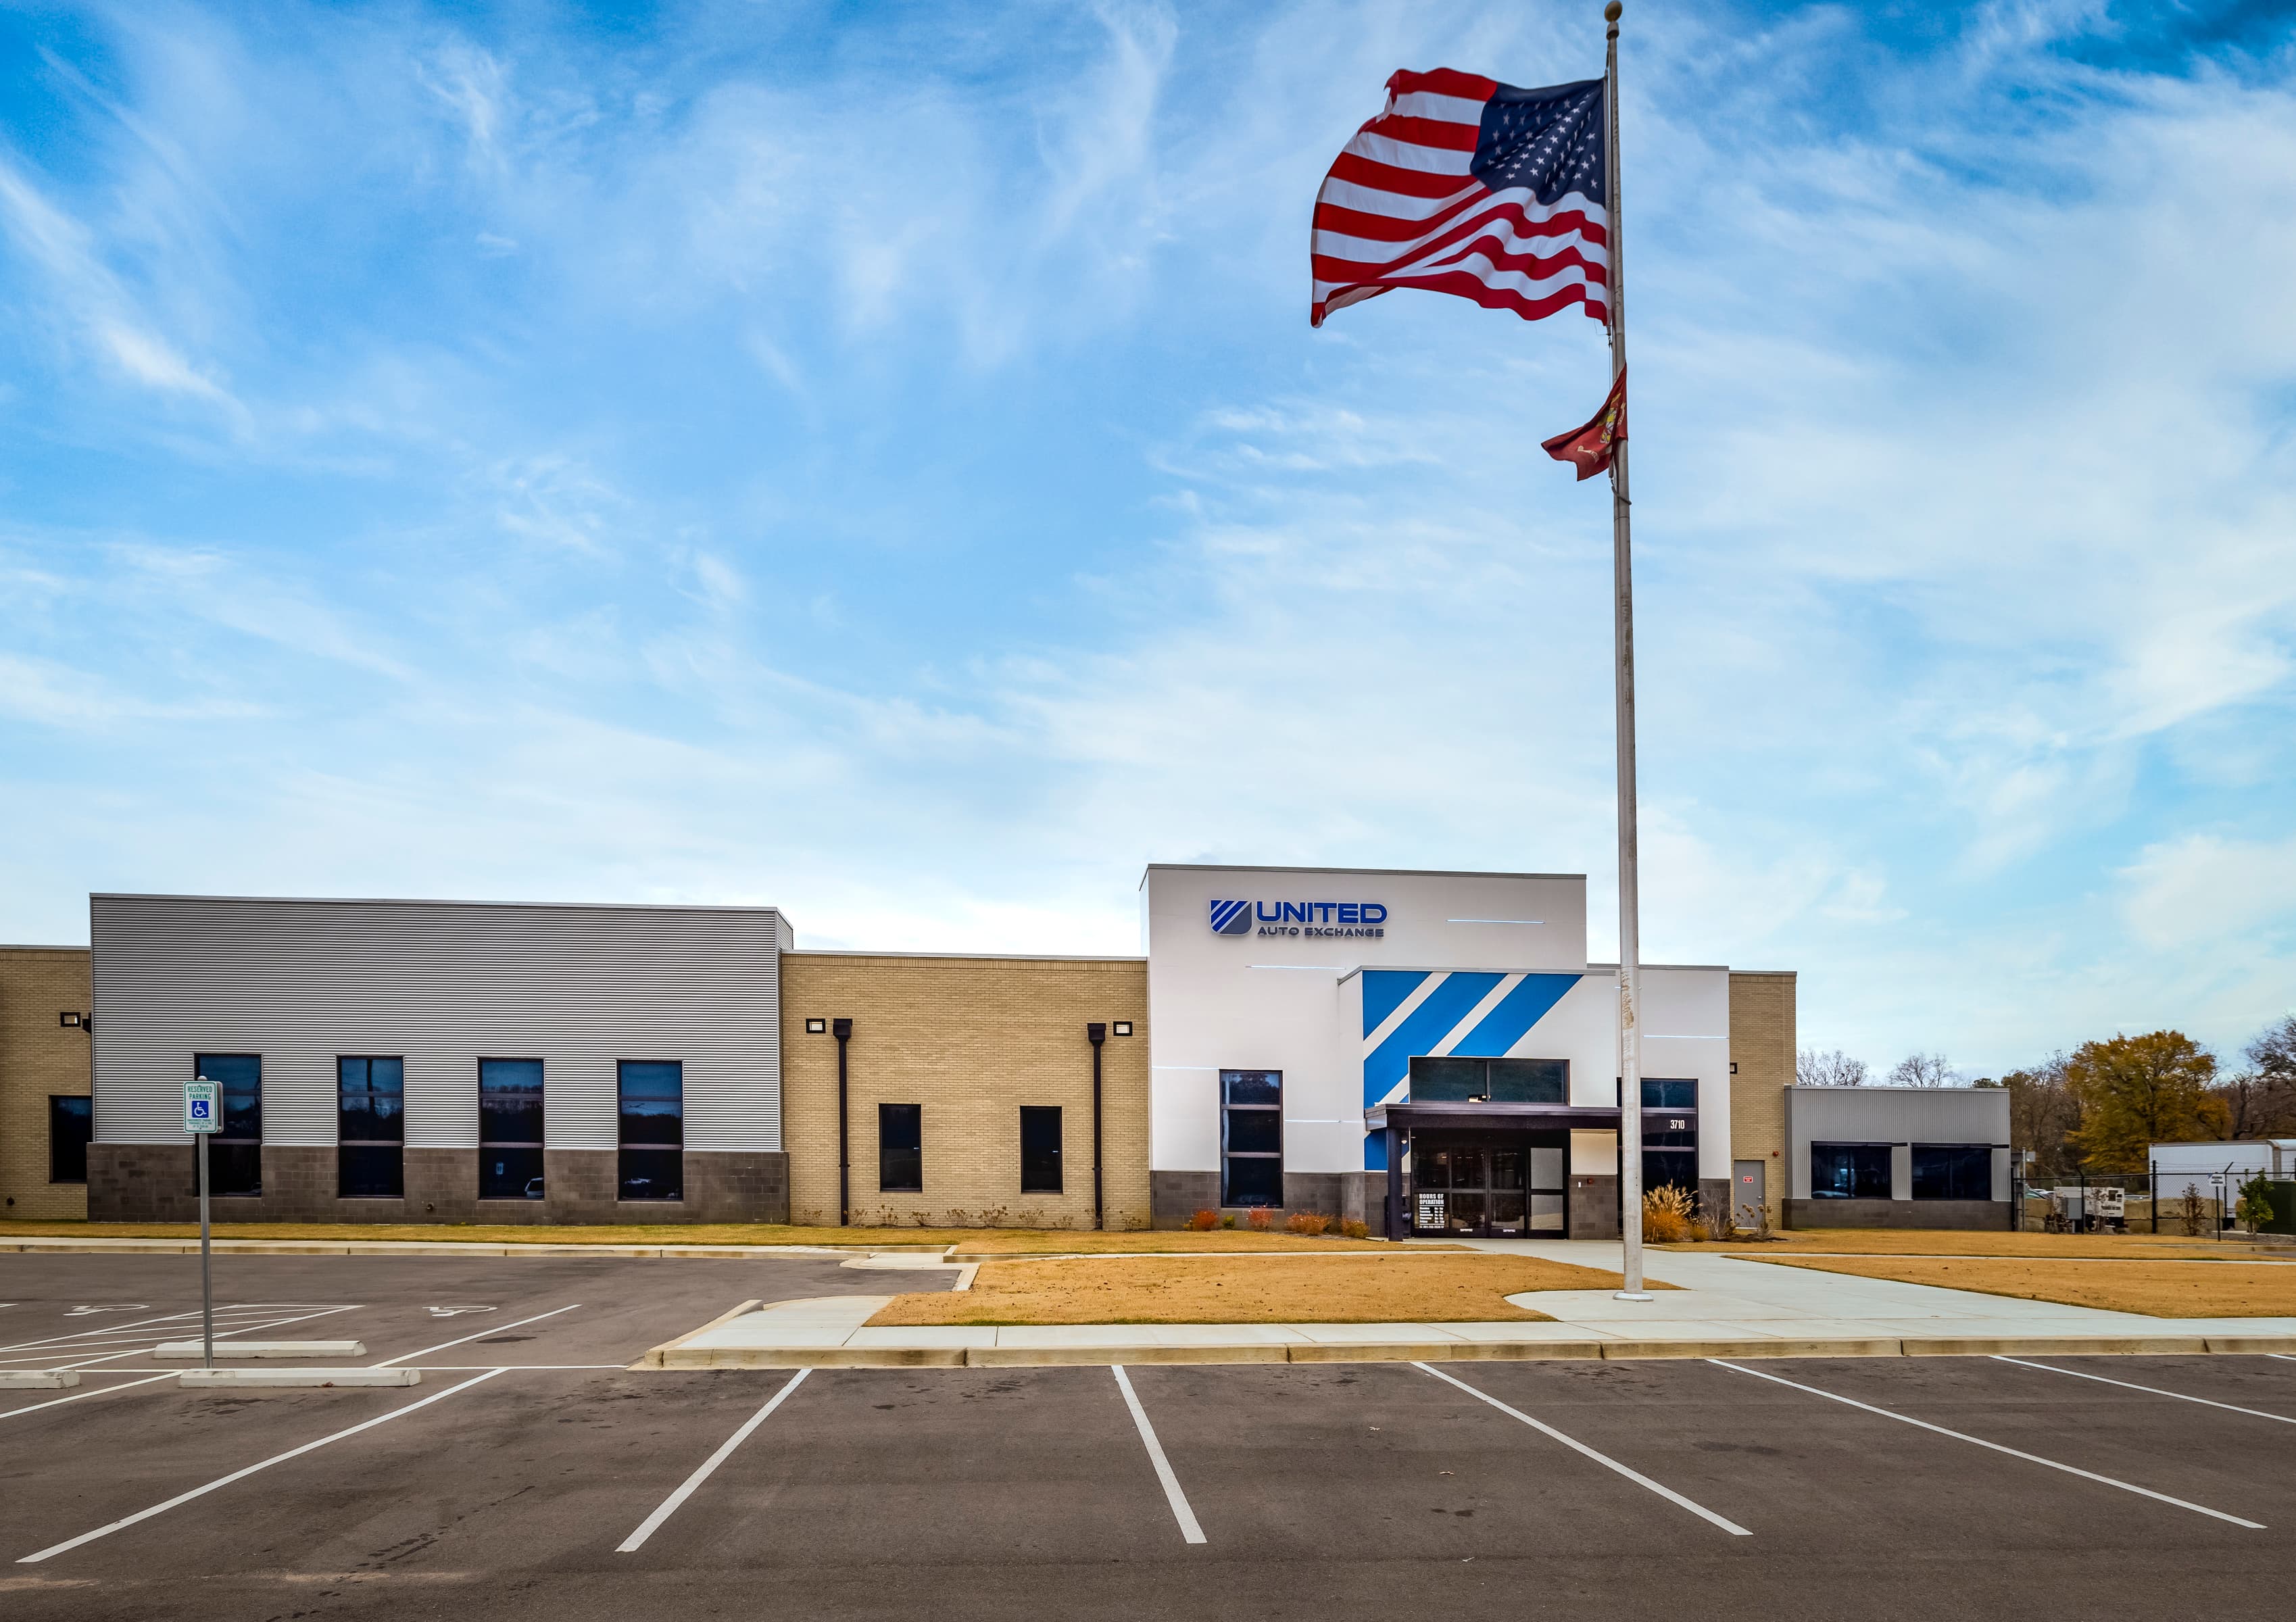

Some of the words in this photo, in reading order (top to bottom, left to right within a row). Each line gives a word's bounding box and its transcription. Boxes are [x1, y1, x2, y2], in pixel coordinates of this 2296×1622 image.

[1256, 901, 1388, 924] UNITED
[1257, 927, 1300, 936] AUTO
[1304, 927, 1384, 937] EXCHANGE
[1670, 1119, 1685, 1129] 3710
